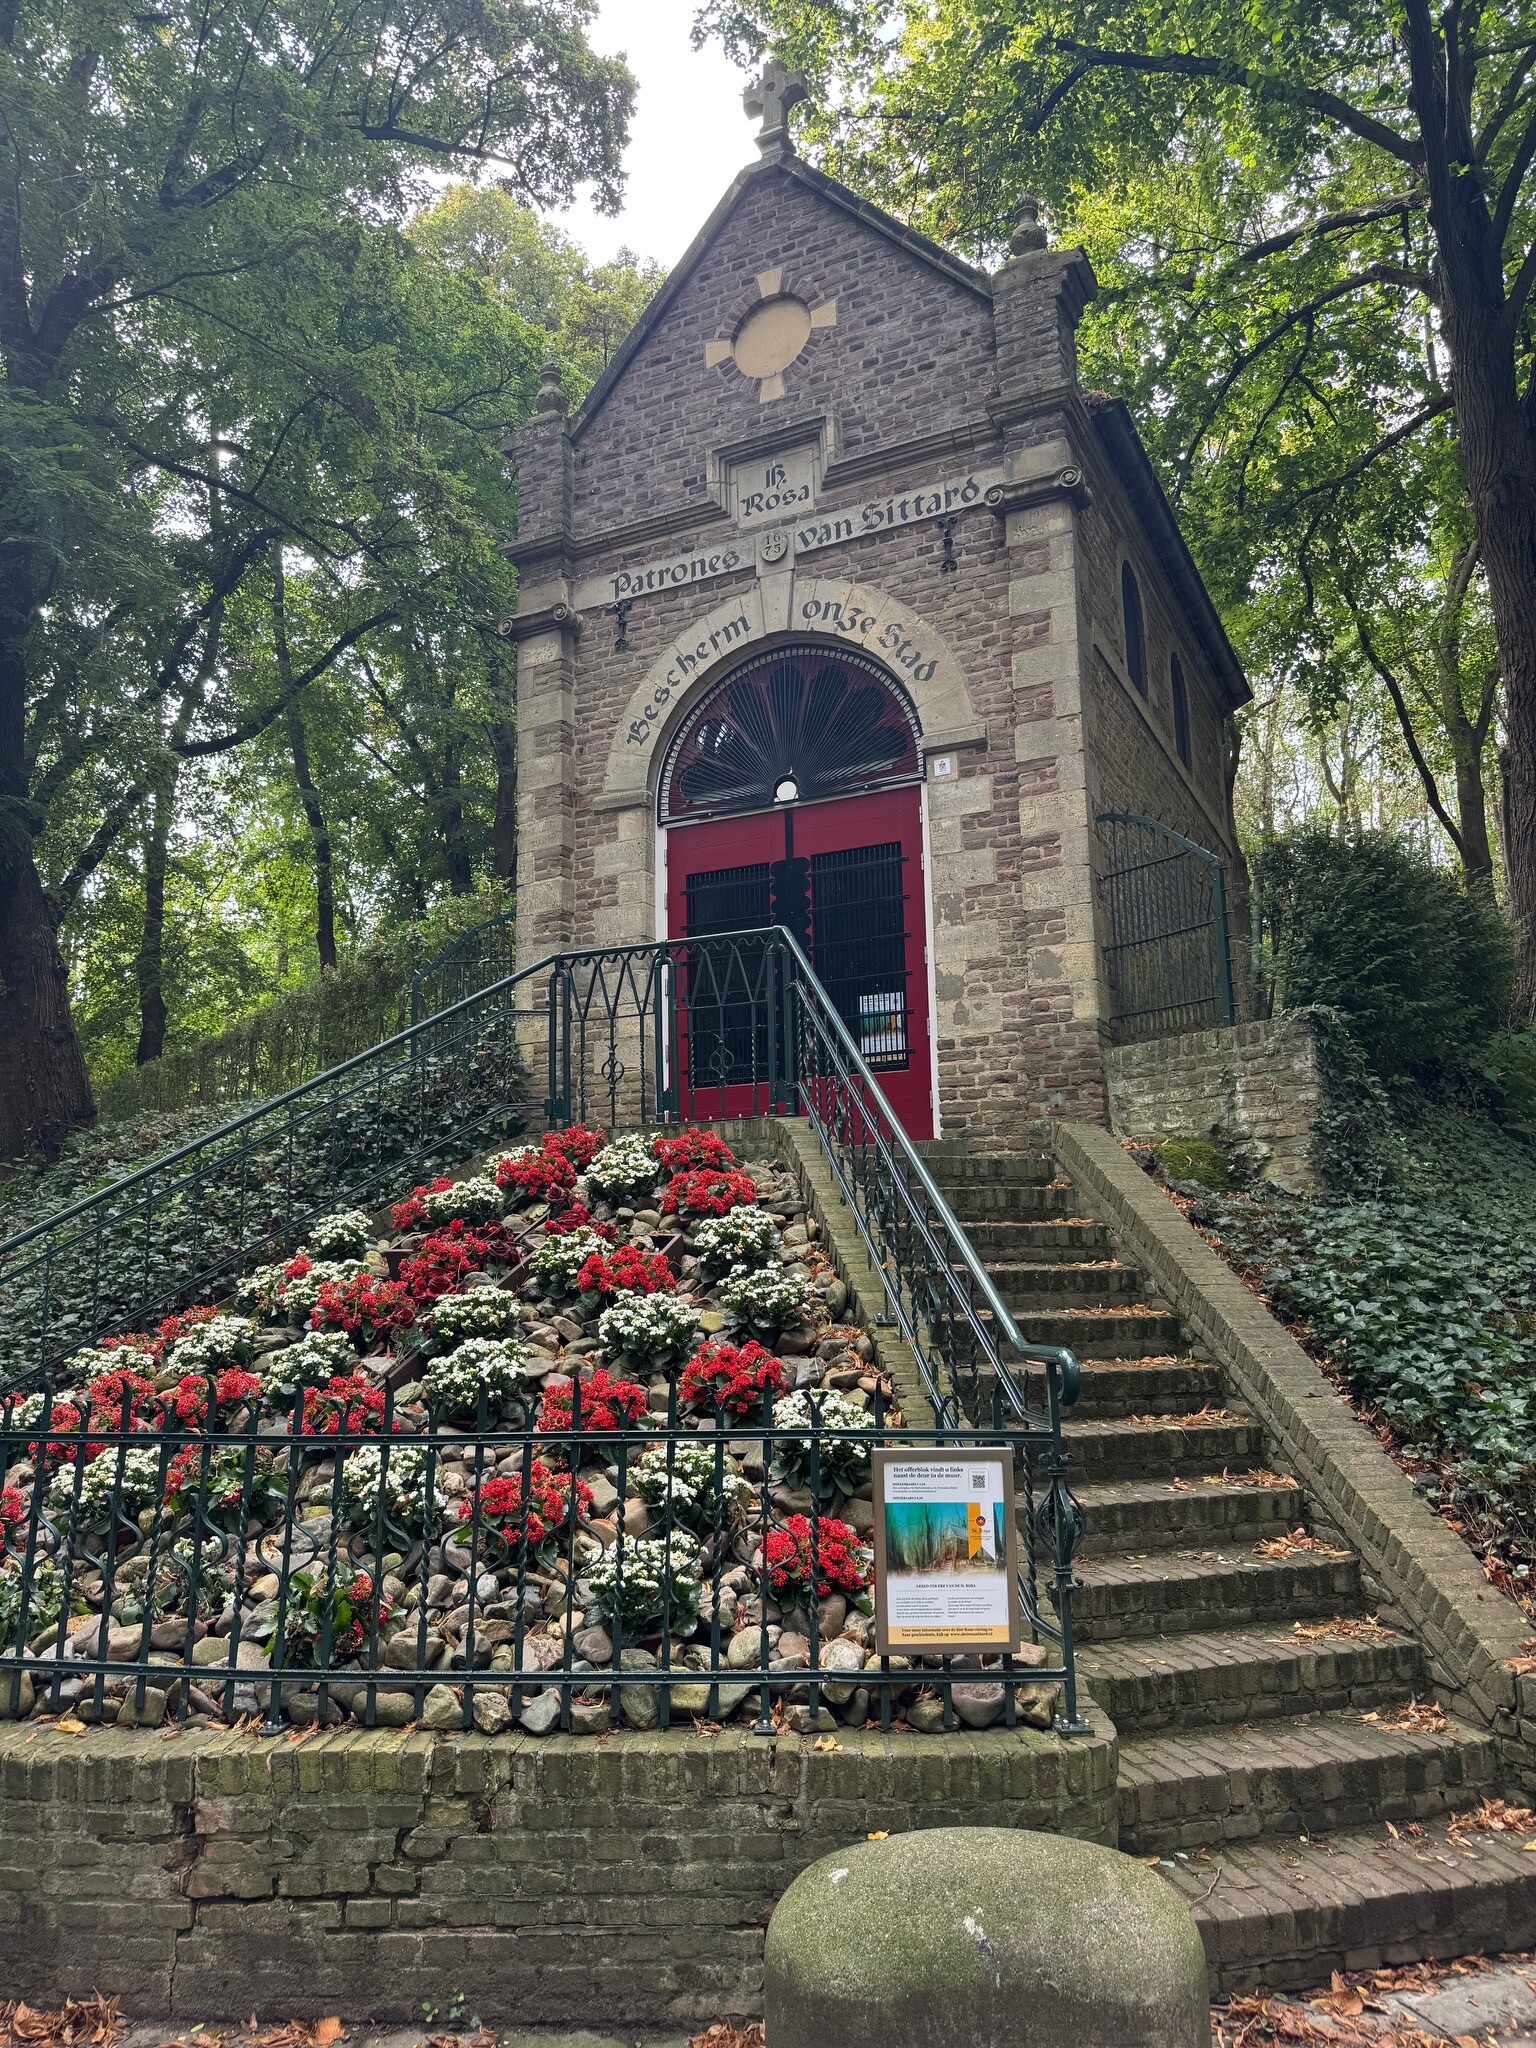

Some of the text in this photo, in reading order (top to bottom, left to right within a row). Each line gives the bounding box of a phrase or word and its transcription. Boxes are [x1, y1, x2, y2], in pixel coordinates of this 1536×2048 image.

[740, 484, 810, 517] Rosa
[609, 476, 980, 601] Patrones van Sittard
[765, 533, 781, 546] 16
[765, 544, 782, 557] 75
[627, 616, 752, 747] Bescherm
[802, 599, 877, 633] onze
[877, 623, 940, 682] Stad
